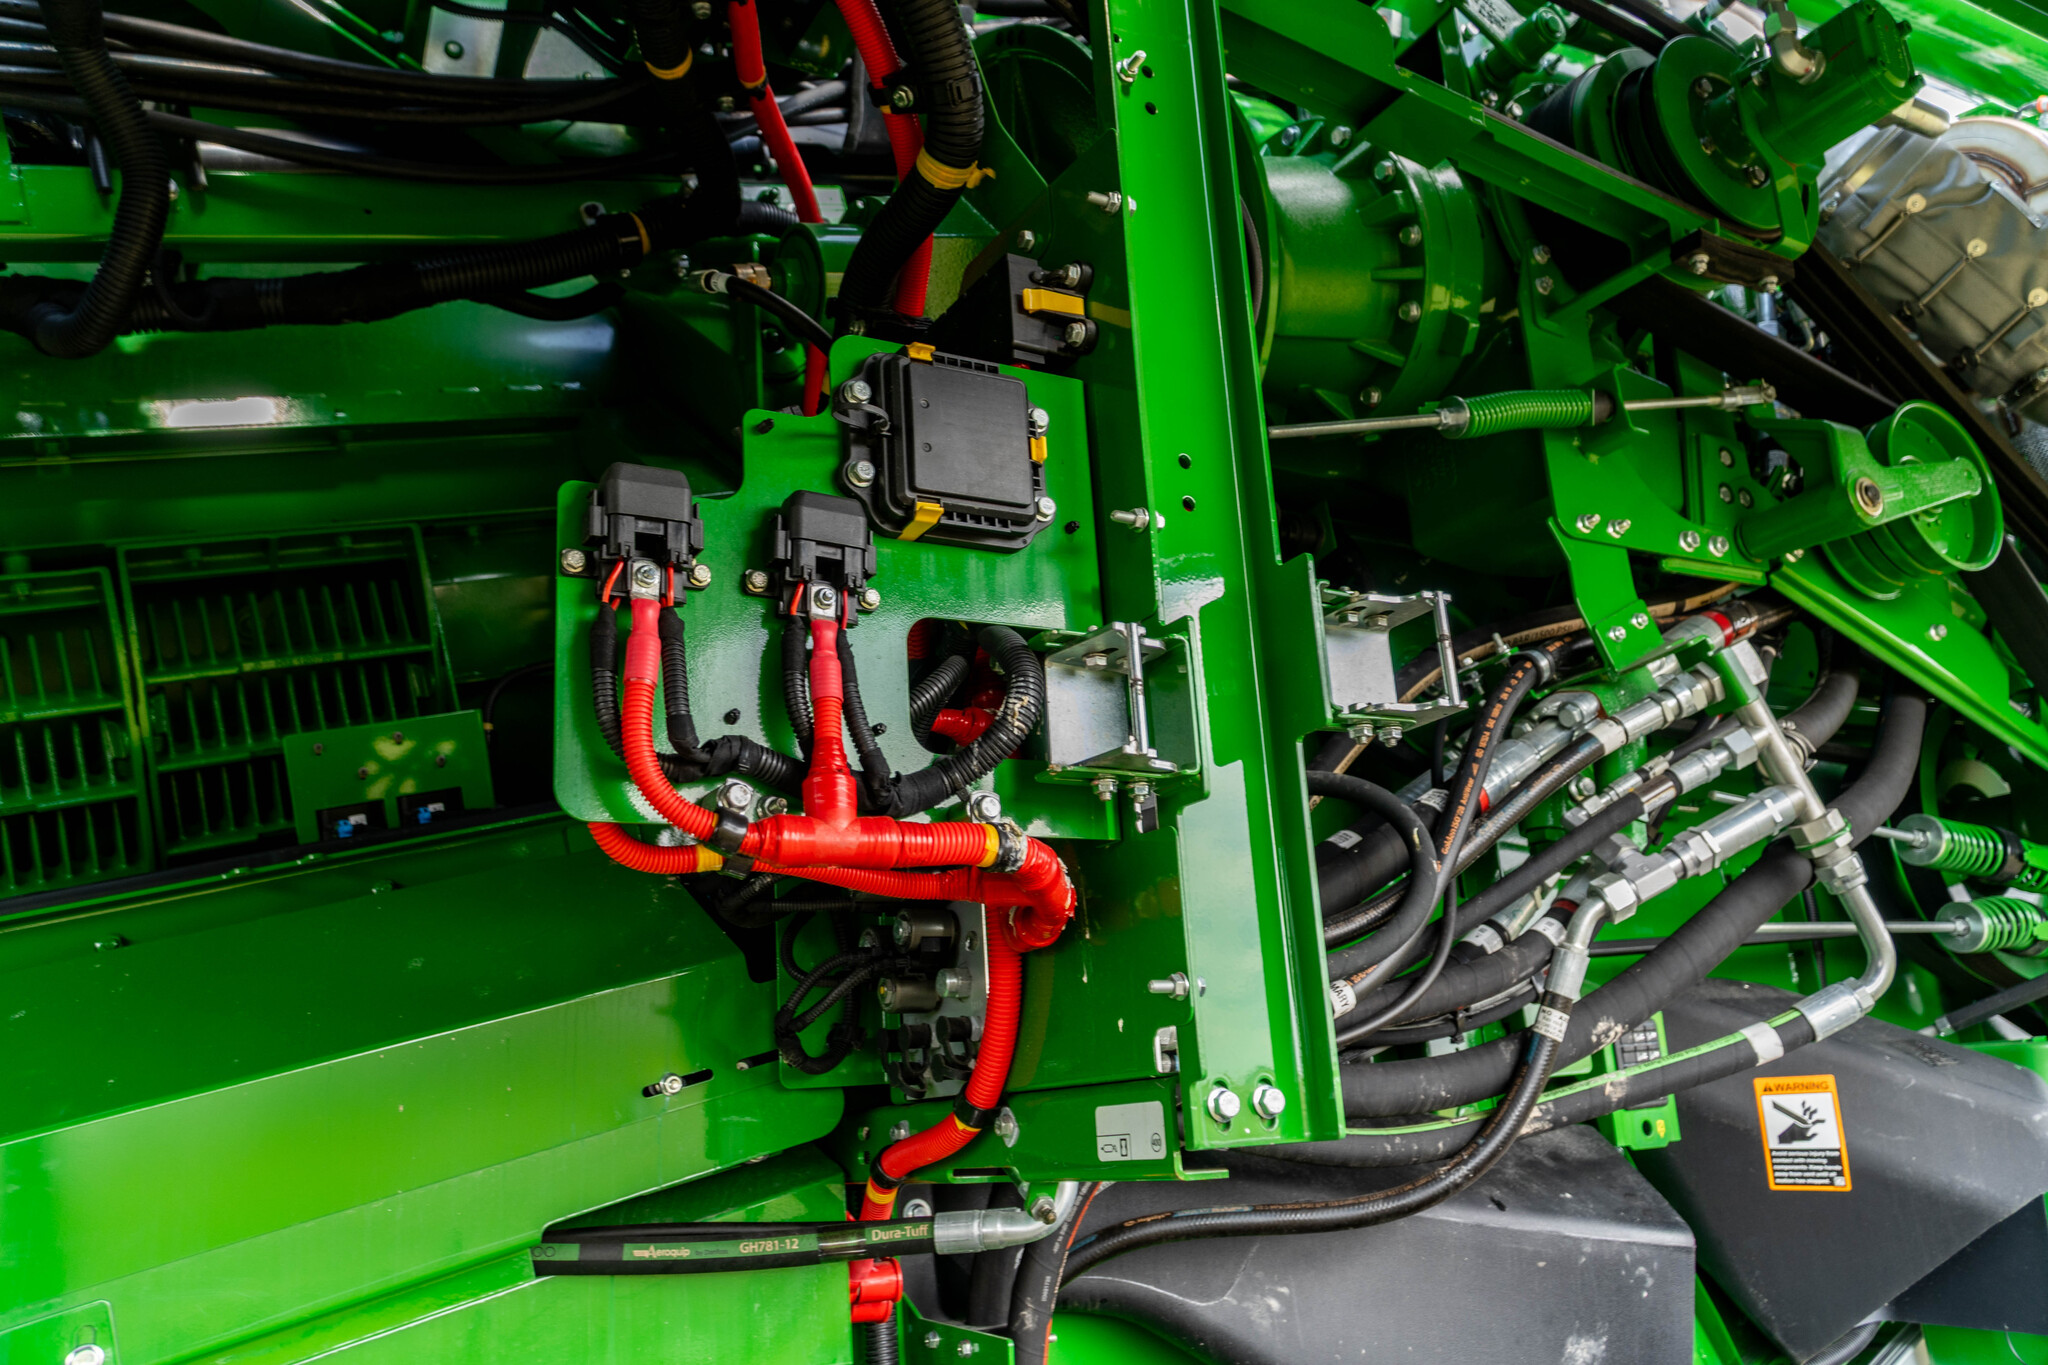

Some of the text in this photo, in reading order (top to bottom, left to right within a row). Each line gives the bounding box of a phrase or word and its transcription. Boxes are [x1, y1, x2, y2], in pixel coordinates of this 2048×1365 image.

[1775, 1081, 1829, 1091] WARNING
[634, 1245, 690, 1258] Aeroquip
[739, 1239, 799, 1253] GH781-12
[871, 1224, 929, 1241] Dura-Tuff
